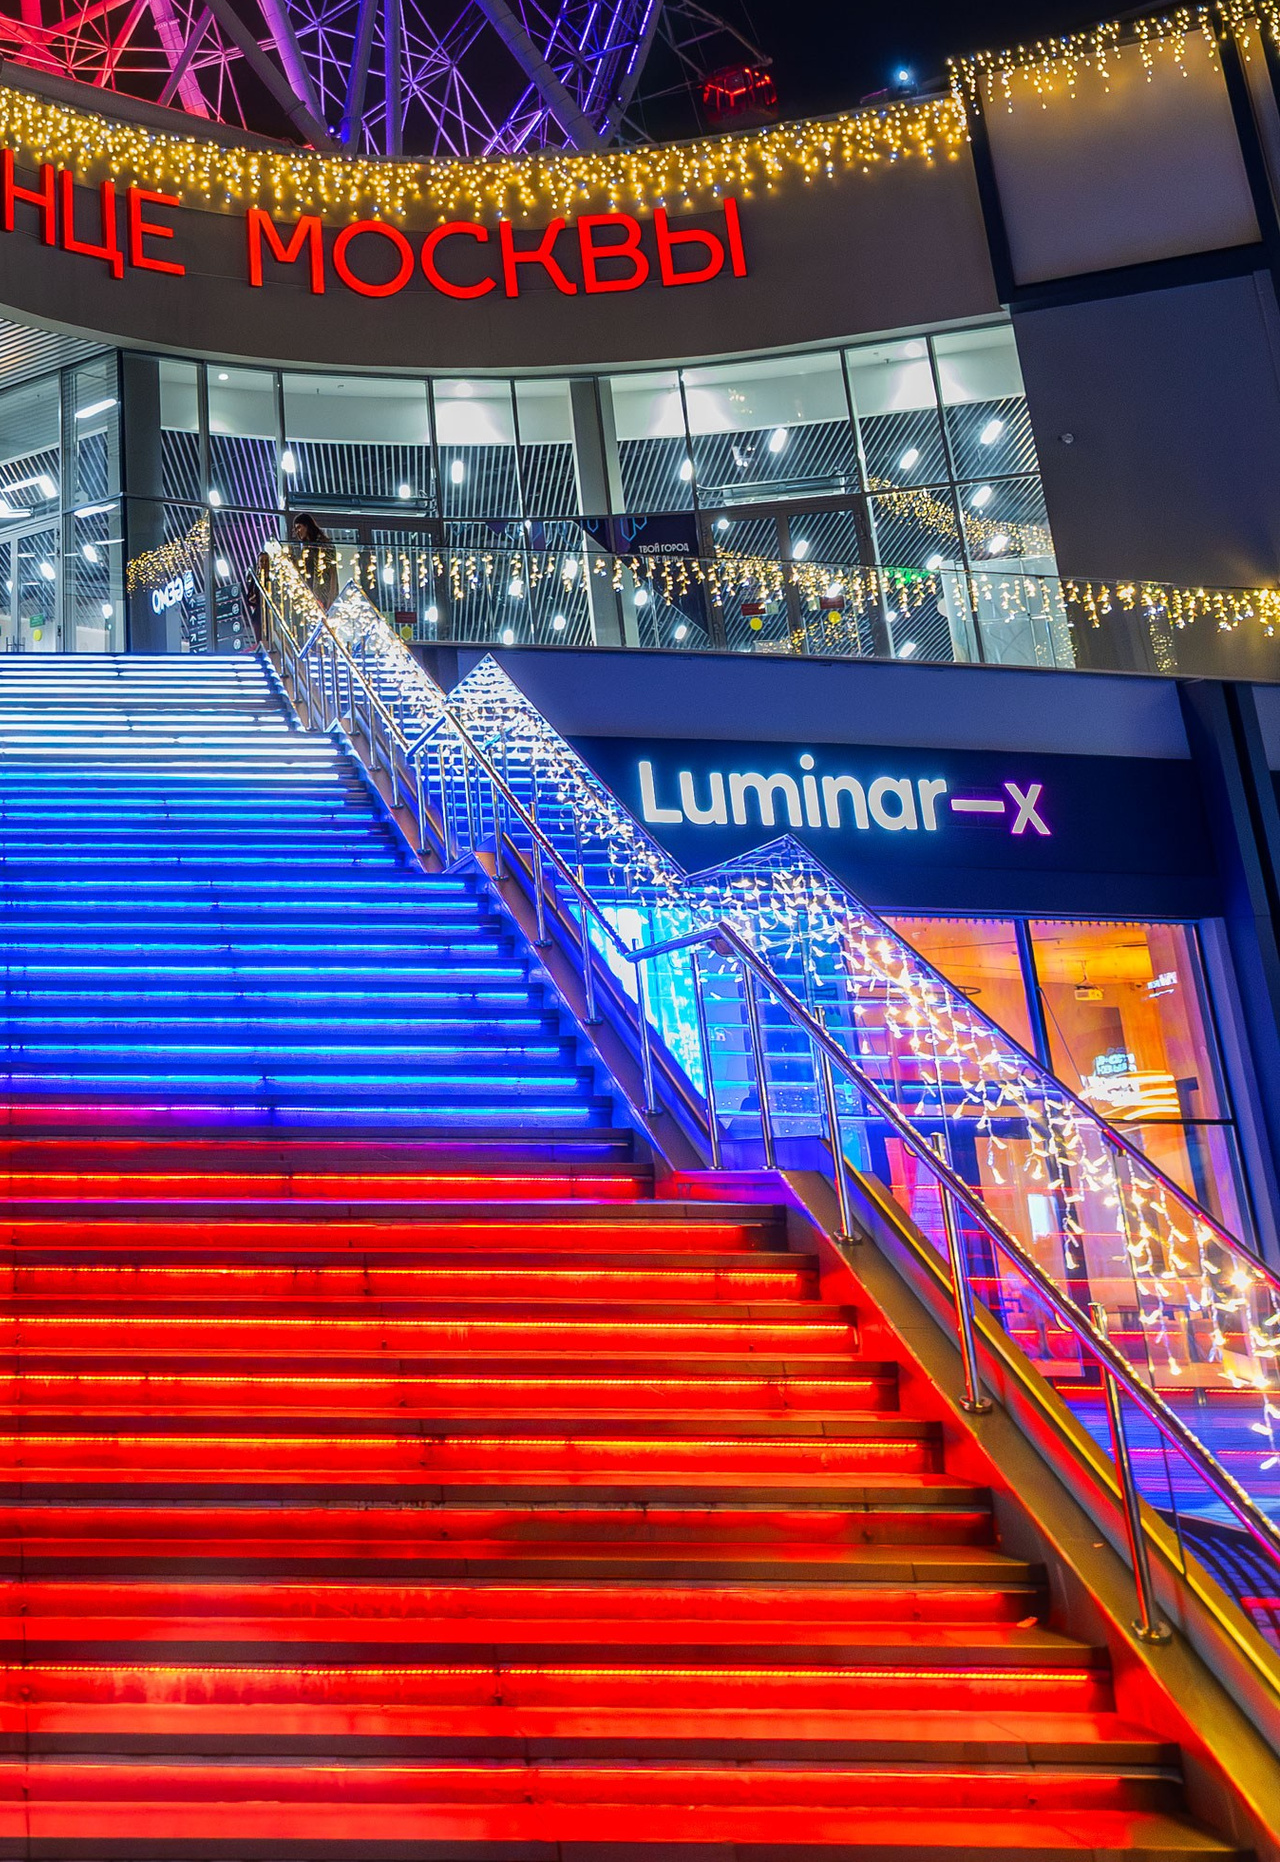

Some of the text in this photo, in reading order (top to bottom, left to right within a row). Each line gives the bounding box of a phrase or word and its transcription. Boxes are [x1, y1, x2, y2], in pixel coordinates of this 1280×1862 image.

[246, 197, 748, 299] МОСКВЫ
[638, 542, 690, 554] ТВОЙ ГОРОД
